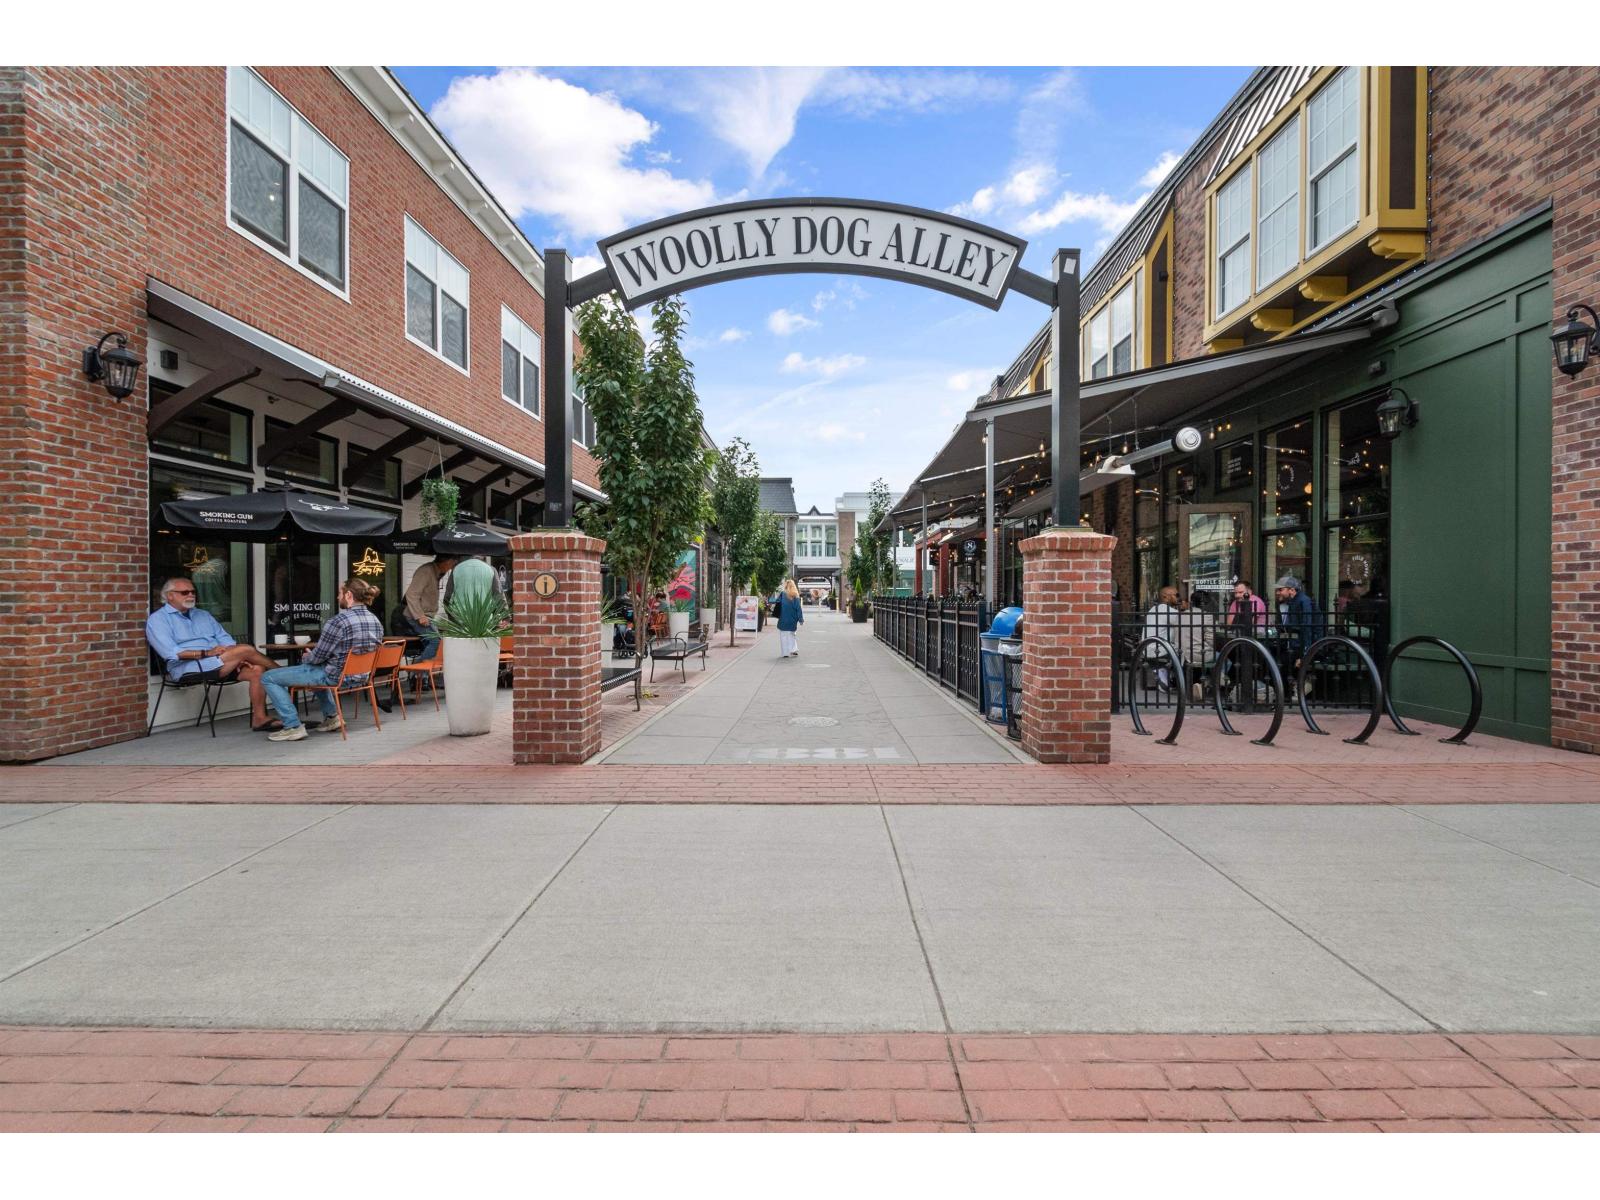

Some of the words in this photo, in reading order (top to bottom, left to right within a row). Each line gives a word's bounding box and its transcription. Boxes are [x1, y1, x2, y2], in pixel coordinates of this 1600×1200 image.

[616, 217, 781, 287] WOOLLY
[792, 216, 872, 257] DOG
[880, 222, 1009, 287] ALLEY
[199, 511, 236, 519] SMOKING
[314, 602, 330, 610] GUN
[280, 612, 300, 625] COFEE
